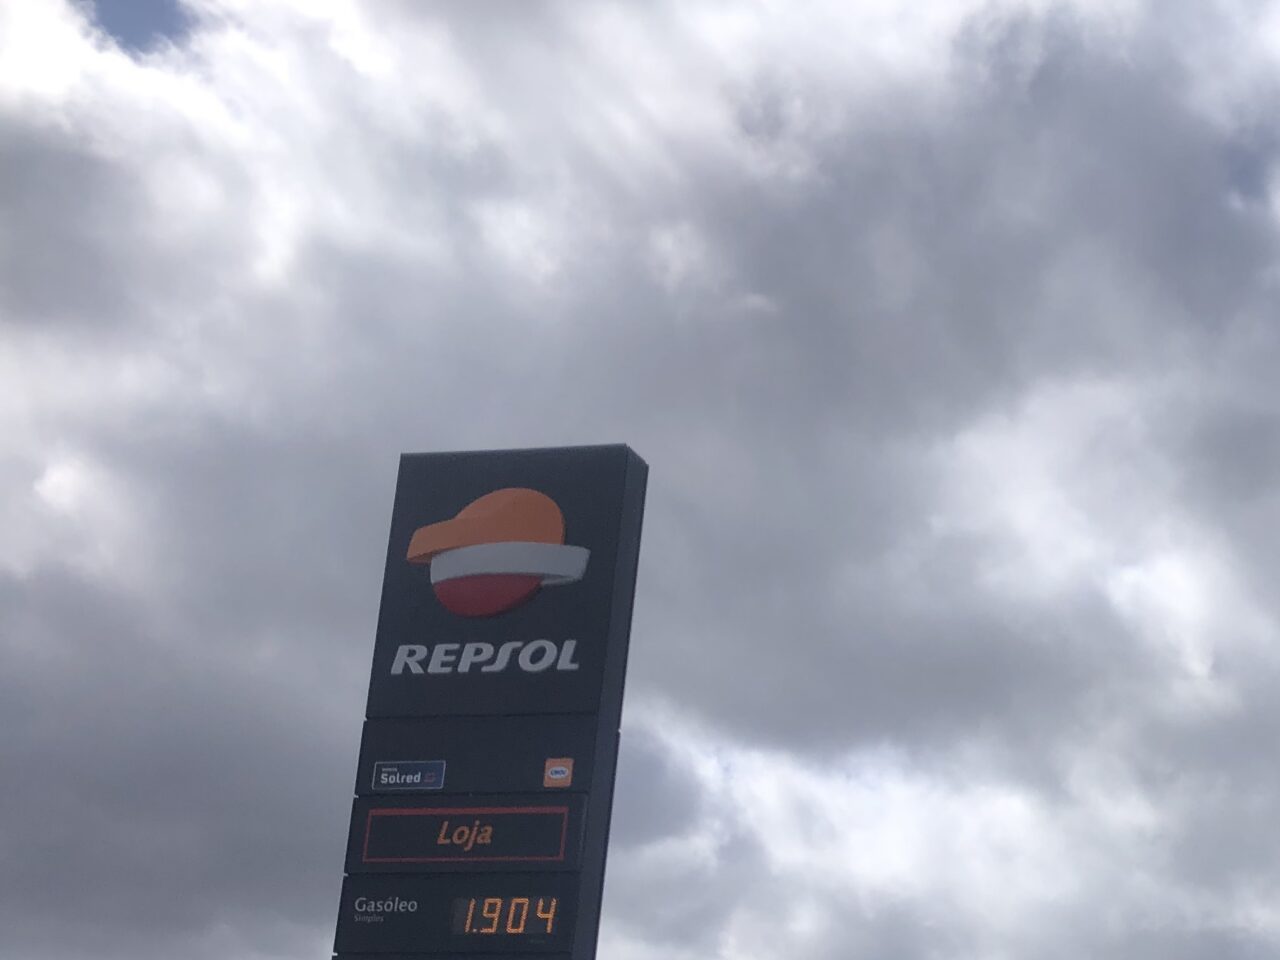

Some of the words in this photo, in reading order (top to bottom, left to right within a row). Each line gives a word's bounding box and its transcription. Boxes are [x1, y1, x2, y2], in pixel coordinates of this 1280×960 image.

[391, 640, 579, 675] REPSOL
[380, 771, 421, 784] Solred
[437, 820, 493, 851] Loja
[354, 897, 418, 912] Gasóleo
[464, 898, 557, 933] 1.904
